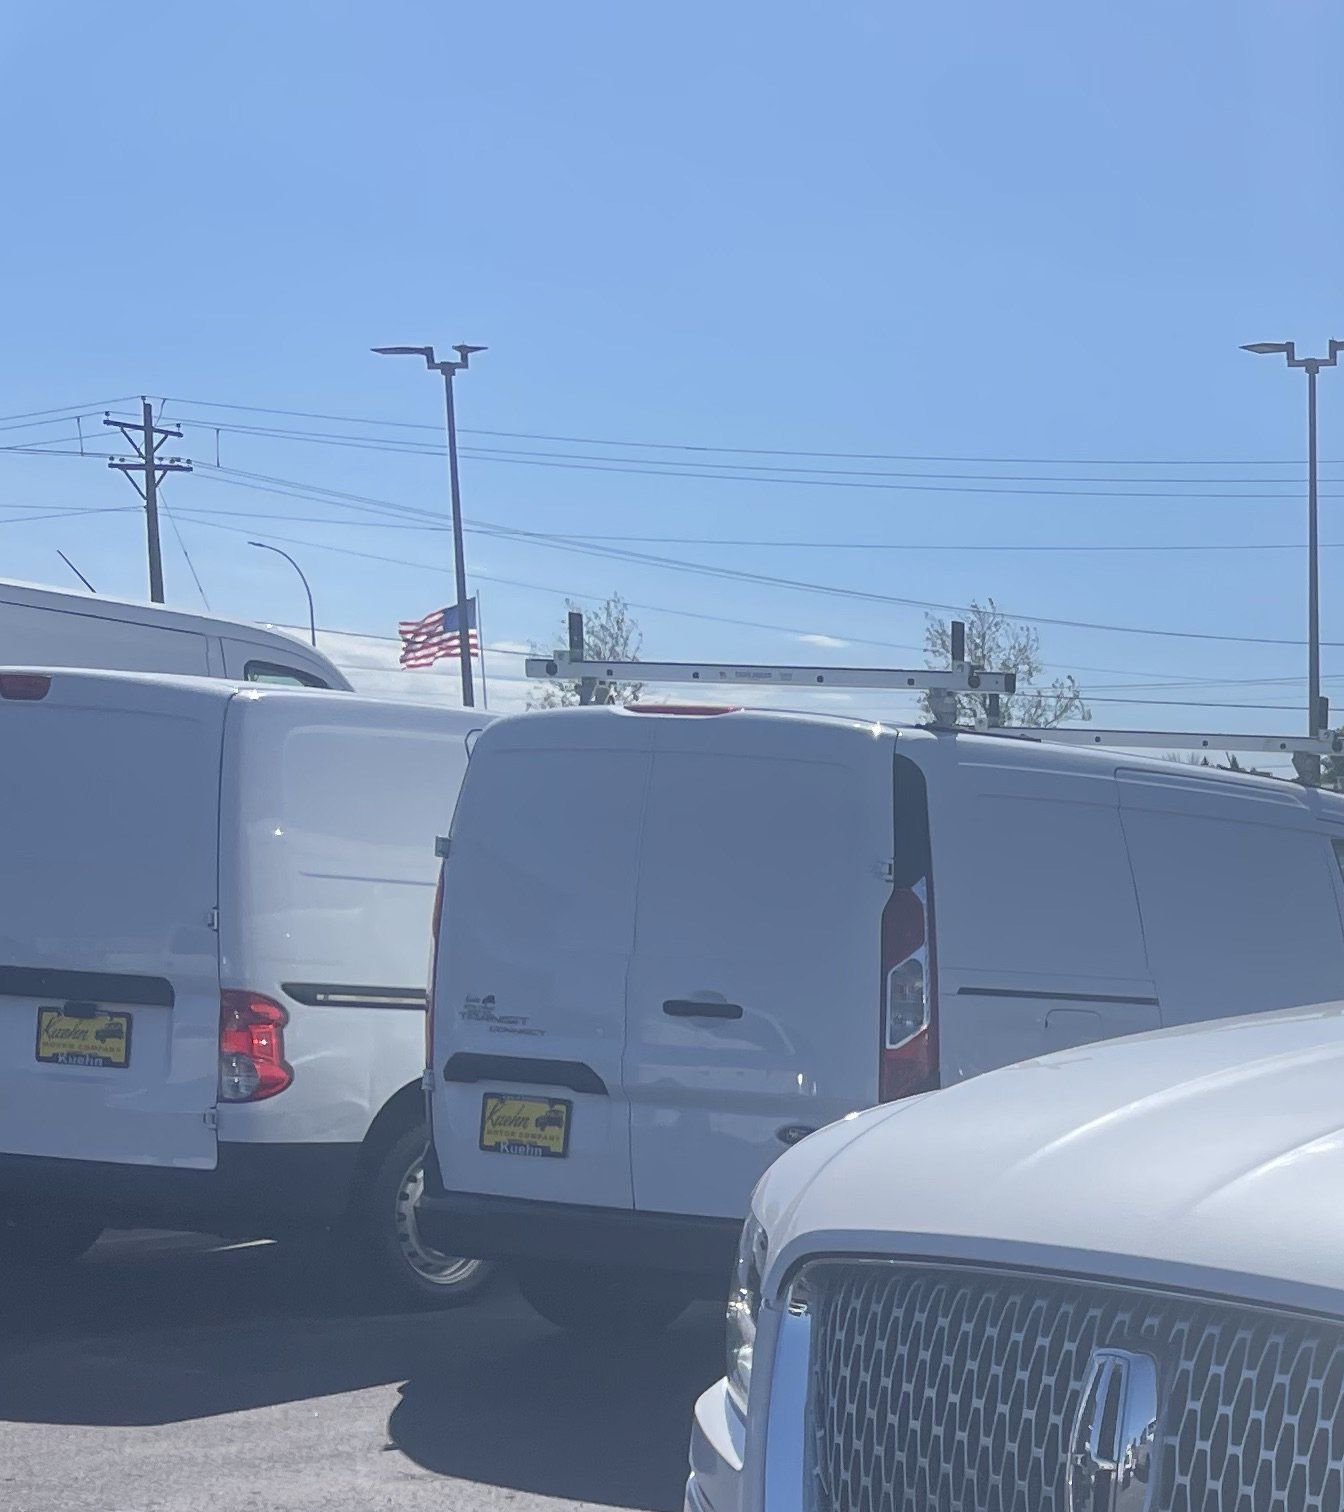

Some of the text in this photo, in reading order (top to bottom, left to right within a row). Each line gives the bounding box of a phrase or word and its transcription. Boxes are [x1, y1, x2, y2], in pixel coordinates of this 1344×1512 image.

[58, 1053, 103, 1066] Kuehn
[487, 1101, 531, 1129] Kuehn
[500, 1140, 543, 1156] Kuehn
